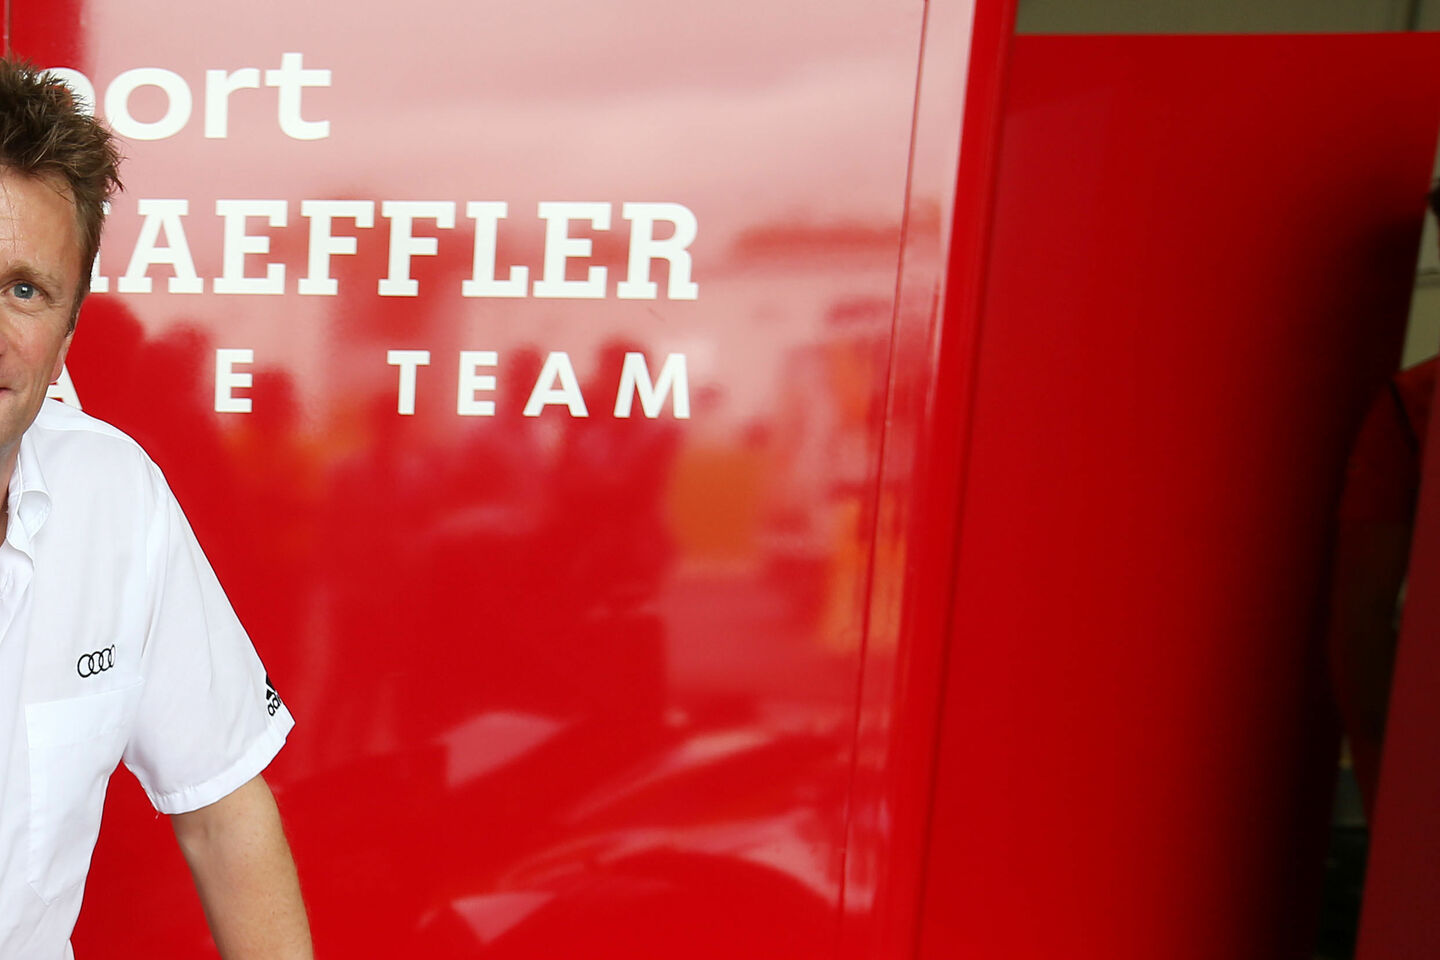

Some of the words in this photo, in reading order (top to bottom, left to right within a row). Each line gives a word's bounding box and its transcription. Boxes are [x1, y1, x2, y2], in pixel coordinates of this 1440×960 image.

[90, 199, 699, 300] AEFFLER
[215, 348, 254, 413] E
[386, 350, 691, 419] TEAM
